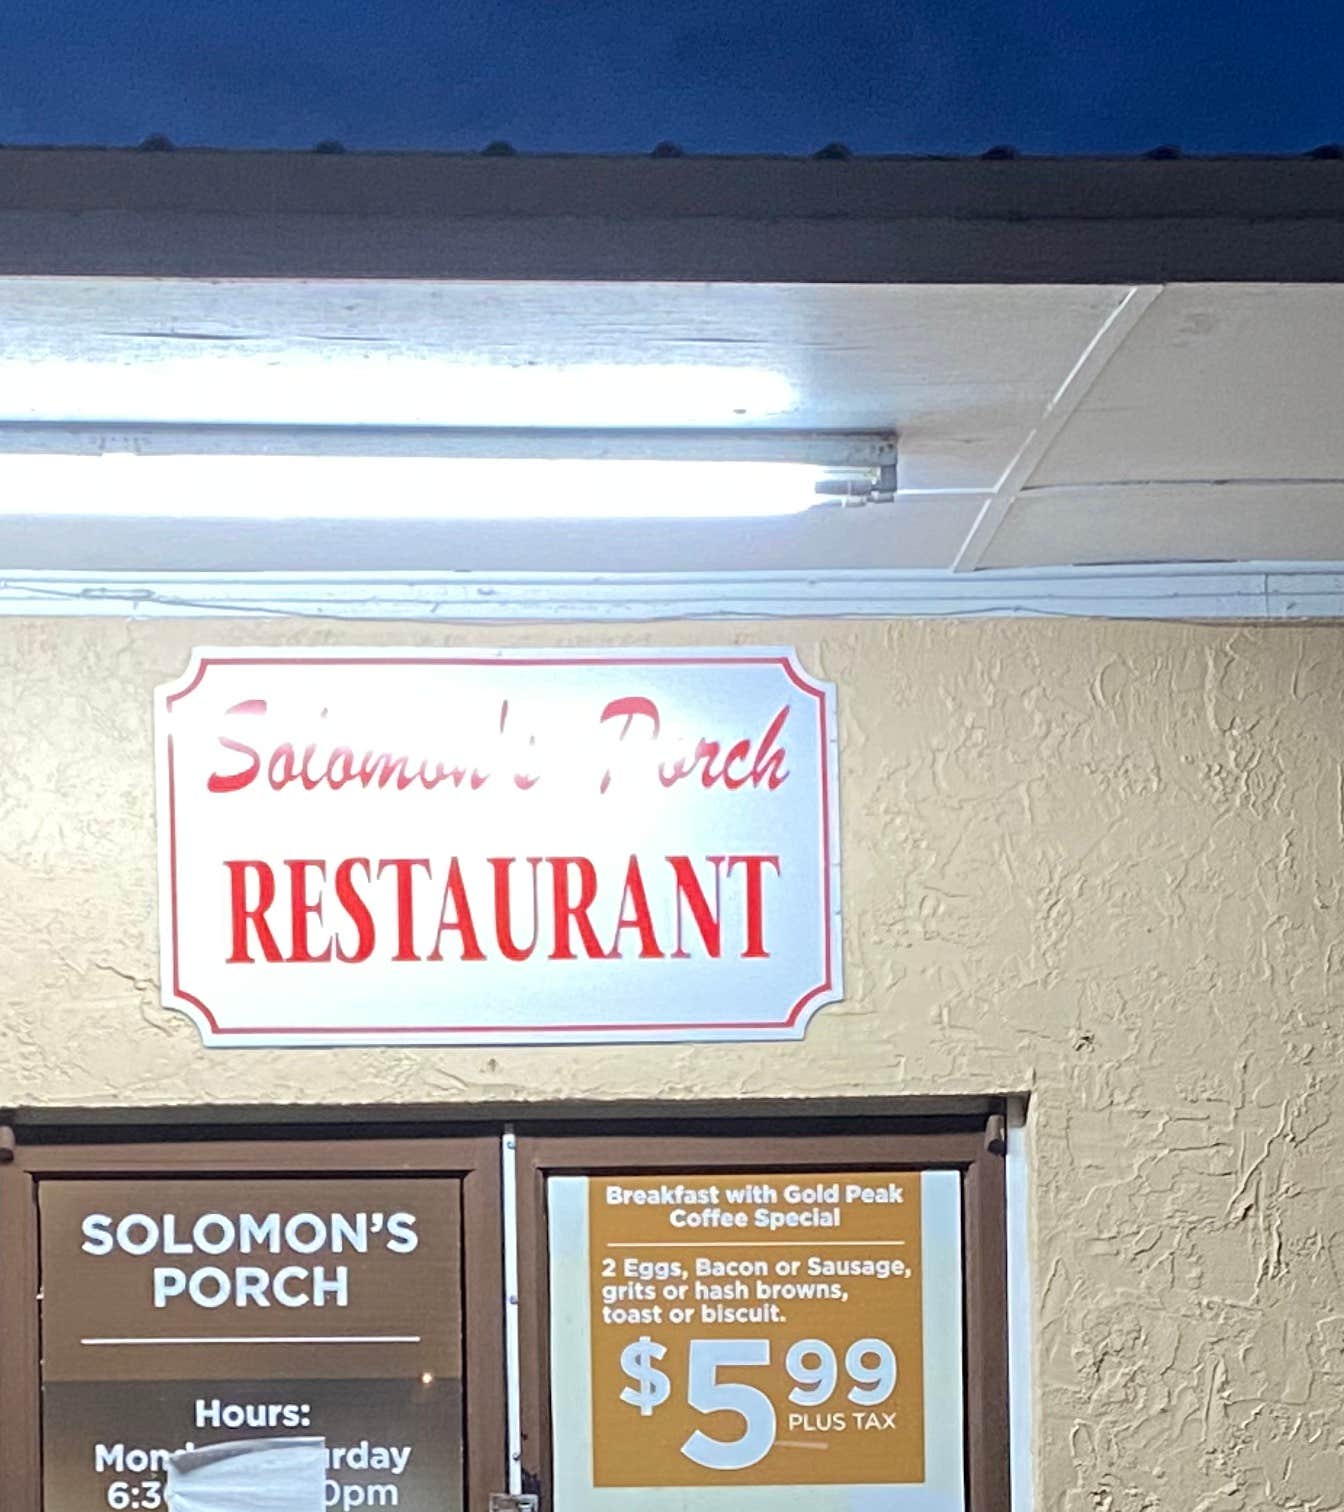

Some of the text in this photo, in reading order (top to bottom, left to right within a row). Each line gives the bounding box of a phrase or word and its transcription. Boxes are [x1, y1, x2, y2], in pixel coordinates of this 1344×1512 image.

[600, 696, 791, 795] Porch
[223, 854, 782, 965] RESTAURANT
[606, 1183, 903, 1205] Breakfast with Gold Peak
[670, 1208, 841, 1230] Coffee Special
[81, 1212, 419, 1256] SOLOMON'S
[602, 1257, 912, 1280] 2 Eggs, Bacon or Sausage,
[154, 1266, 348, 1308] PORCH
[602, 1280, 848, 1303] grits or hash browns,
[602, 1304, 786, 1324] toast or biscuit.
[195, 1399, 311, 1428] Hours:
[789, 1412, 896, 1431] PLUS TAX
